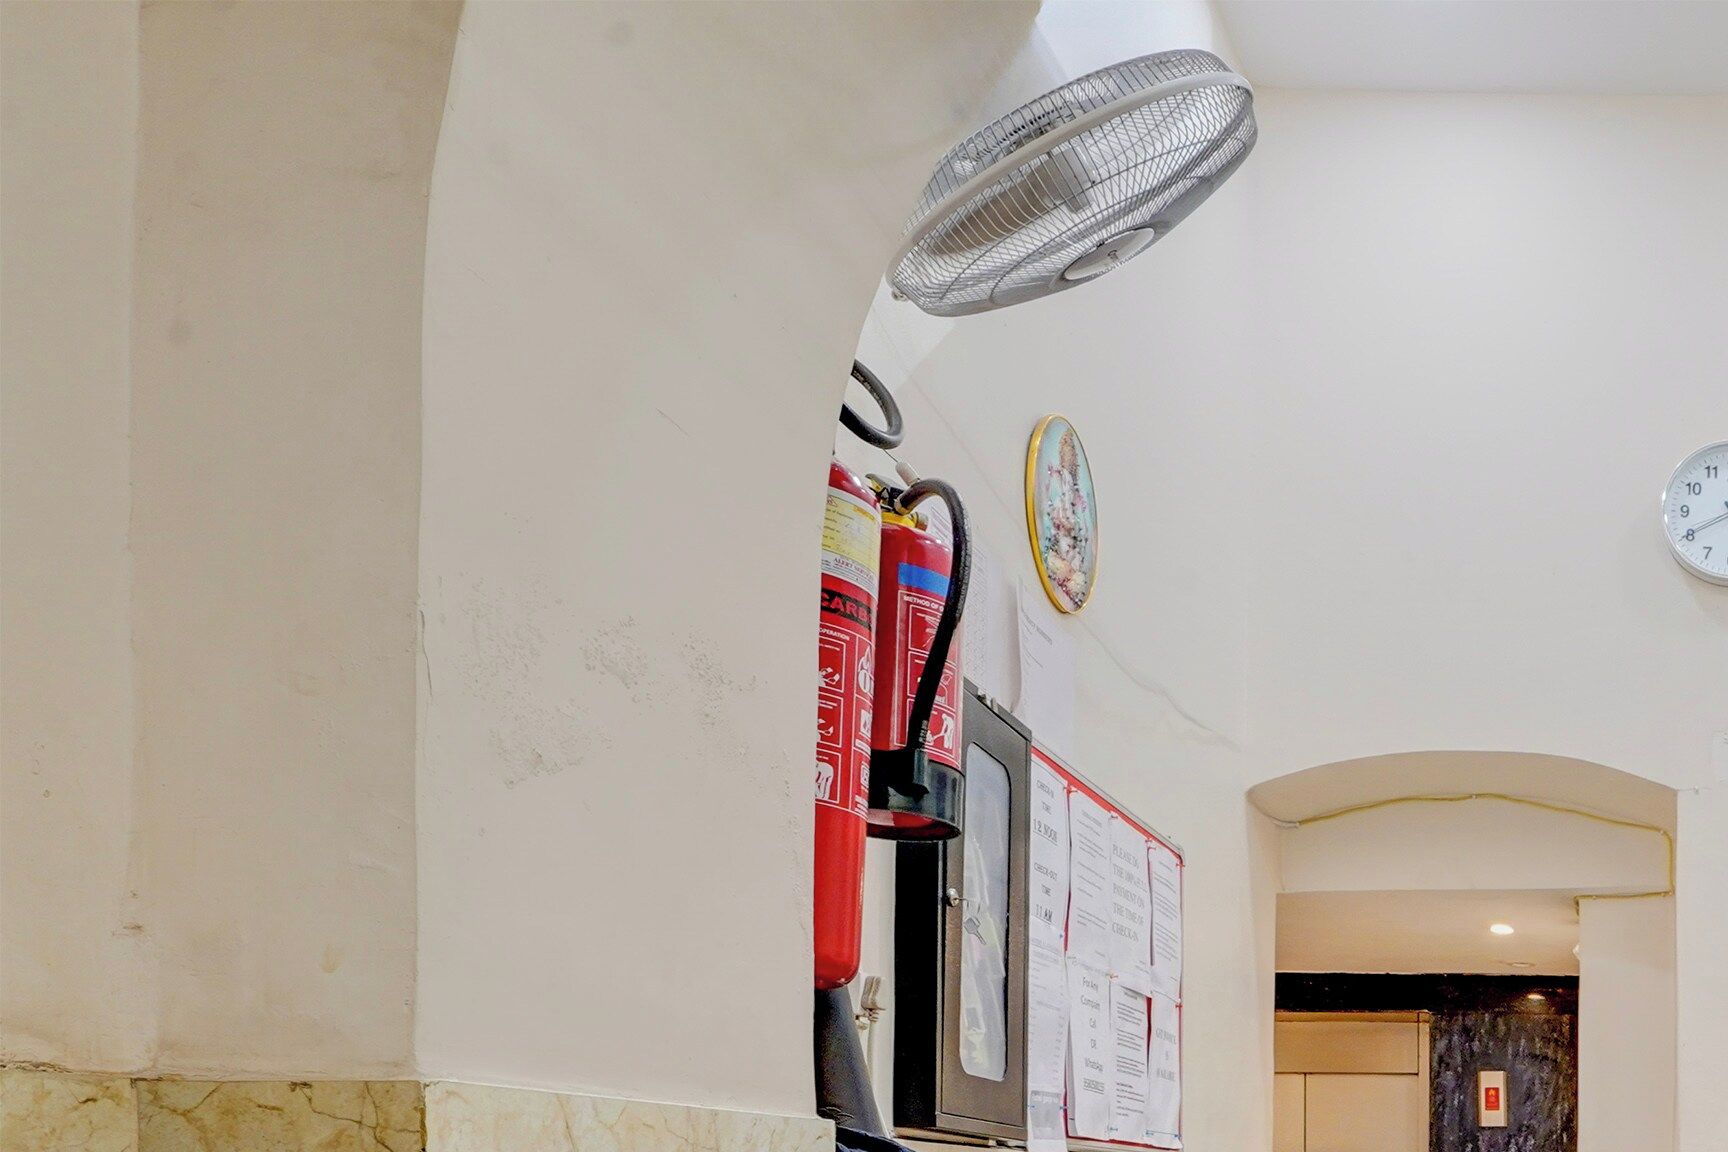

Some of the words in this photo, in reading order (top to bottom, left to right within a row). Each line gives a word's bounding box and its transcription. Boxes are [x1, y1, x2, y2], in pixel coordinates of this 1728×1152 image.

[1704, 465, 1719, 479] 11
[1685, 482, 1702, 496] 10
[1679, 504, 1690, 518] 9
[1685, 528, 1696, 542] 8
[1702, 546, 1713, 560] 7
[903, 594, 930, 607] METHOD
[930, 602, 940, 610] OF
